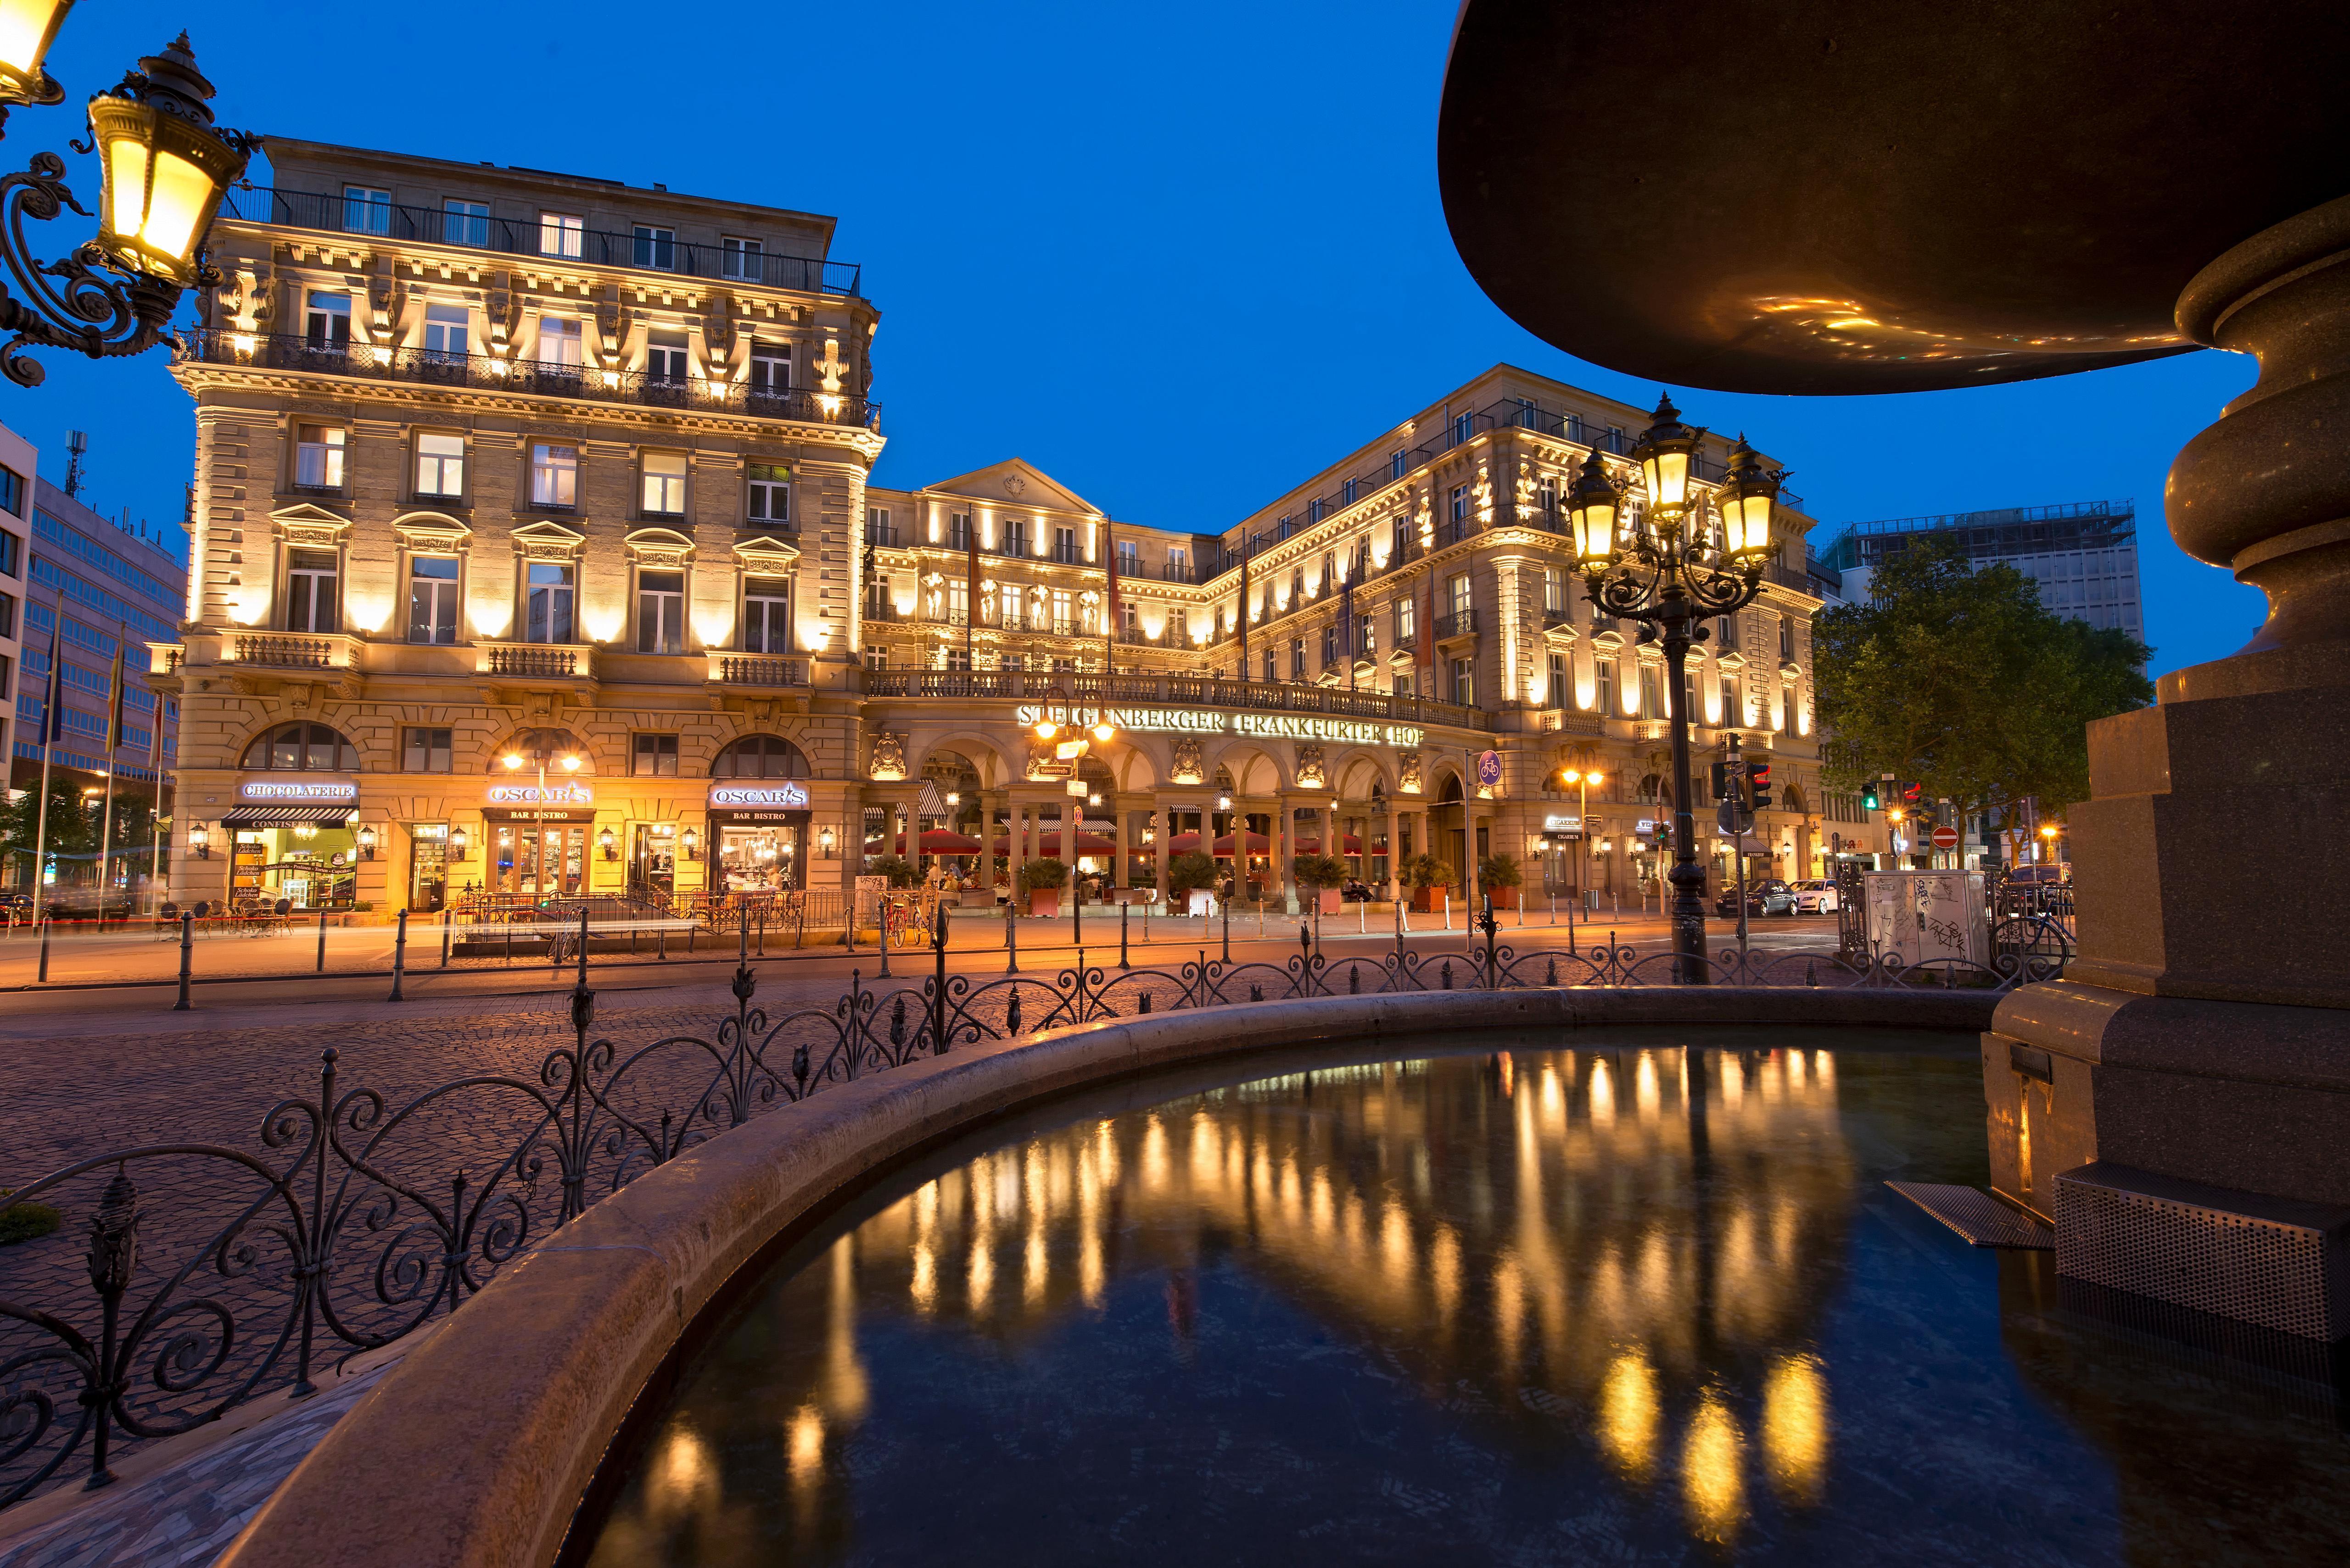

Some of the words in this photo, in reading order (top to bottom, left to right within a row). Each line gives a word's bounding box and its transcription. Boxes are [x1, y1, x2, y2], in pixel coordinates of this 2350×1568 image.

[1239, 714, 1382, 741] FRANKFURTER
[1392, 726, 1424, 744] HOF
[245, 785, 352, 797] CHOCOLATERIE
